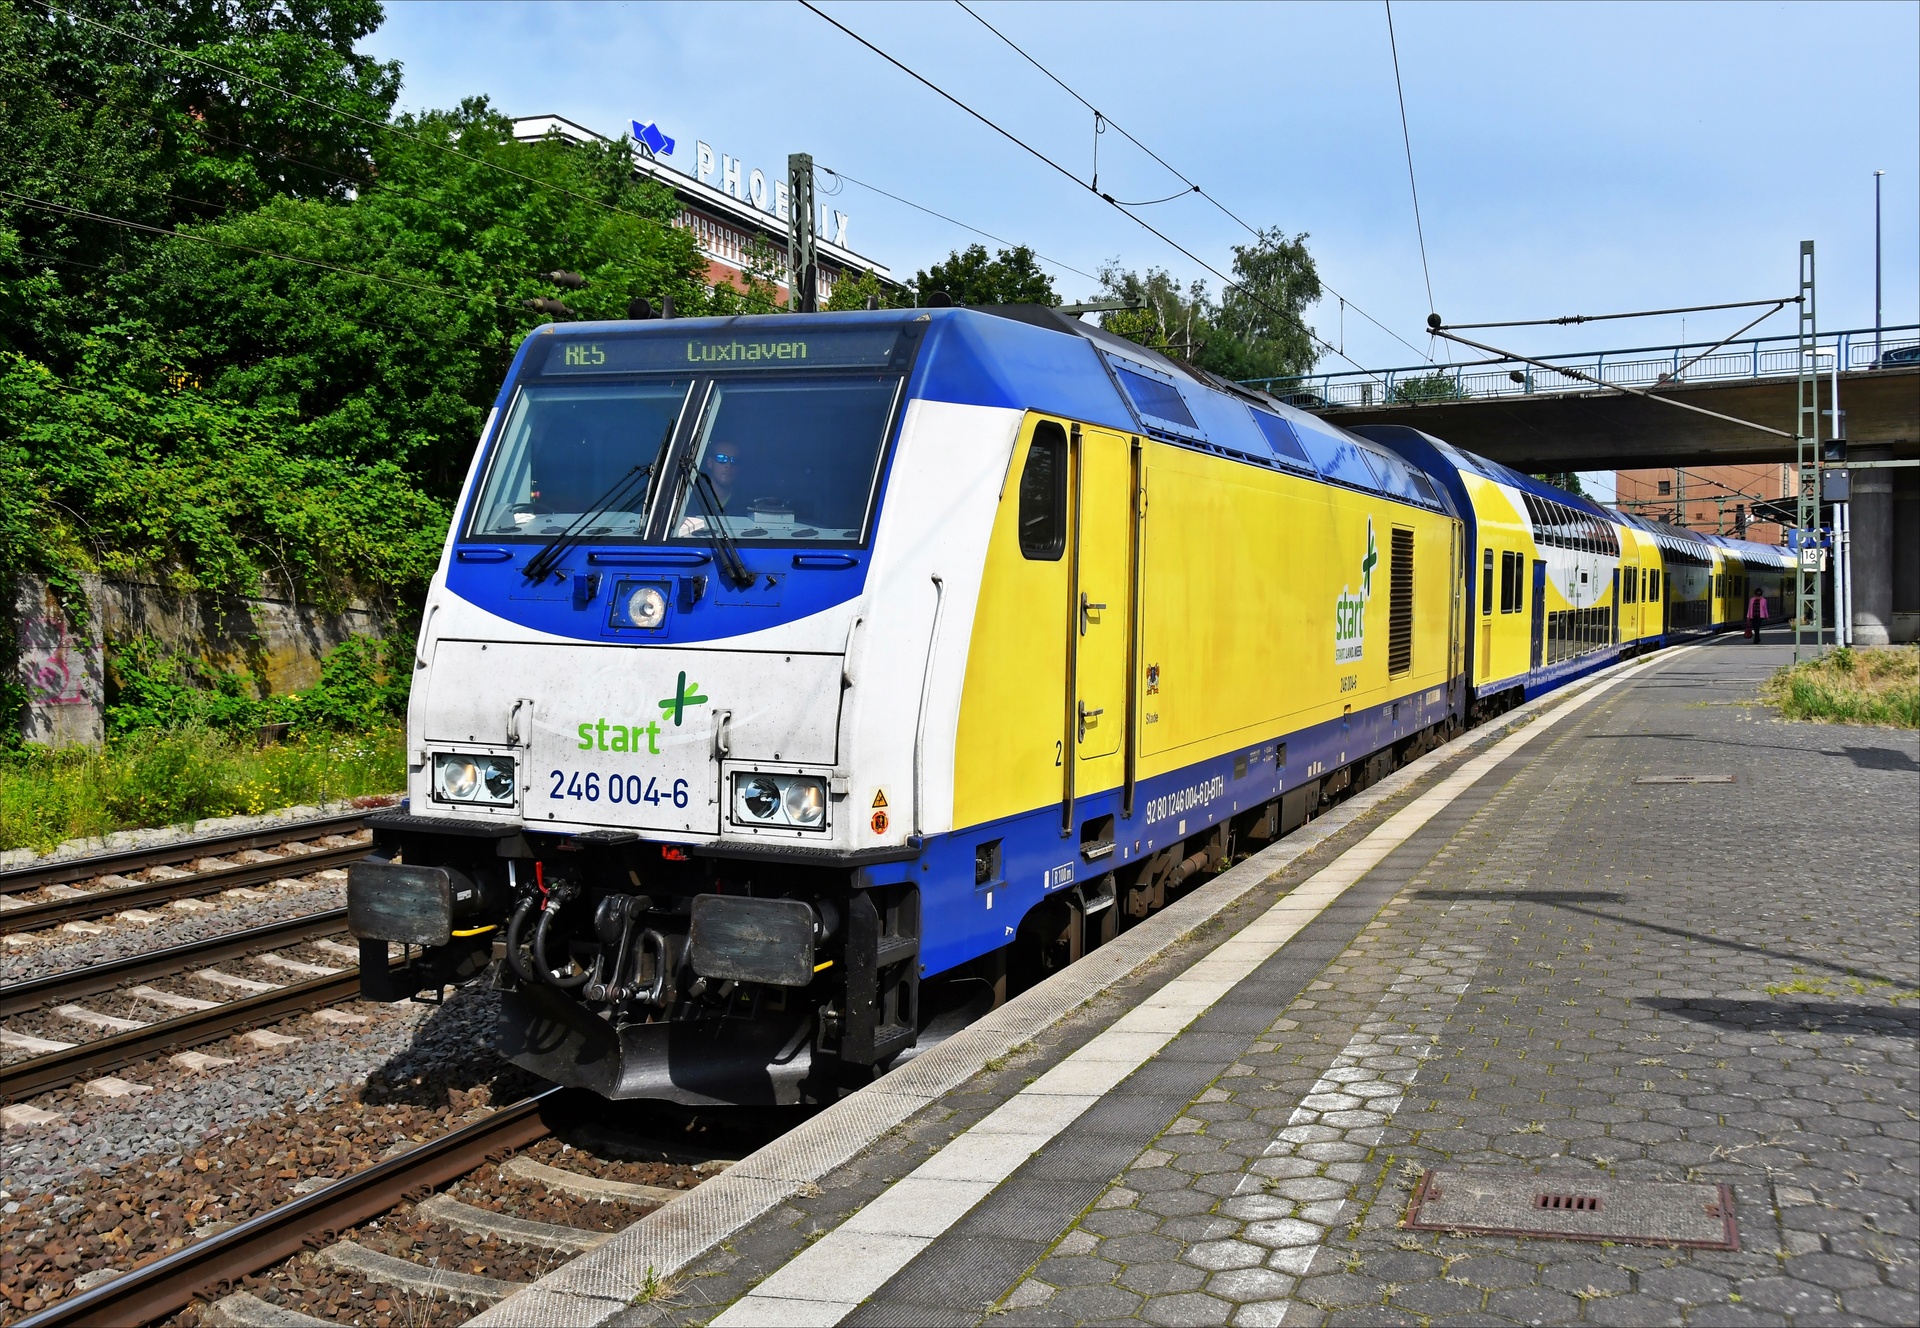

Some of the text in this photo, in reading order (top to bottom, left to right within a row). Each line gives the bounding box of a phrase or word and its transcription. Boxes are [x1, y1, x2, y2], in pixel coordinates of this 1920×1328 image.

[695, 139, 849, 250] PHOEIX
[564, 340, 807, 366] RE5 Cuxhaven
[1336, 591, 1364, 641] start
[577, 717, 662, 755] start
[1055, 740, 1063, 767] 2
[549, 769, 690, 809] 246 004-6
[1146, 799, 1156, 825] 92
[1157, 795, 1167, 821] 80
[1168, 789, 1185, 817] 1246
[1185, 782, 1204, 810] 004-6
